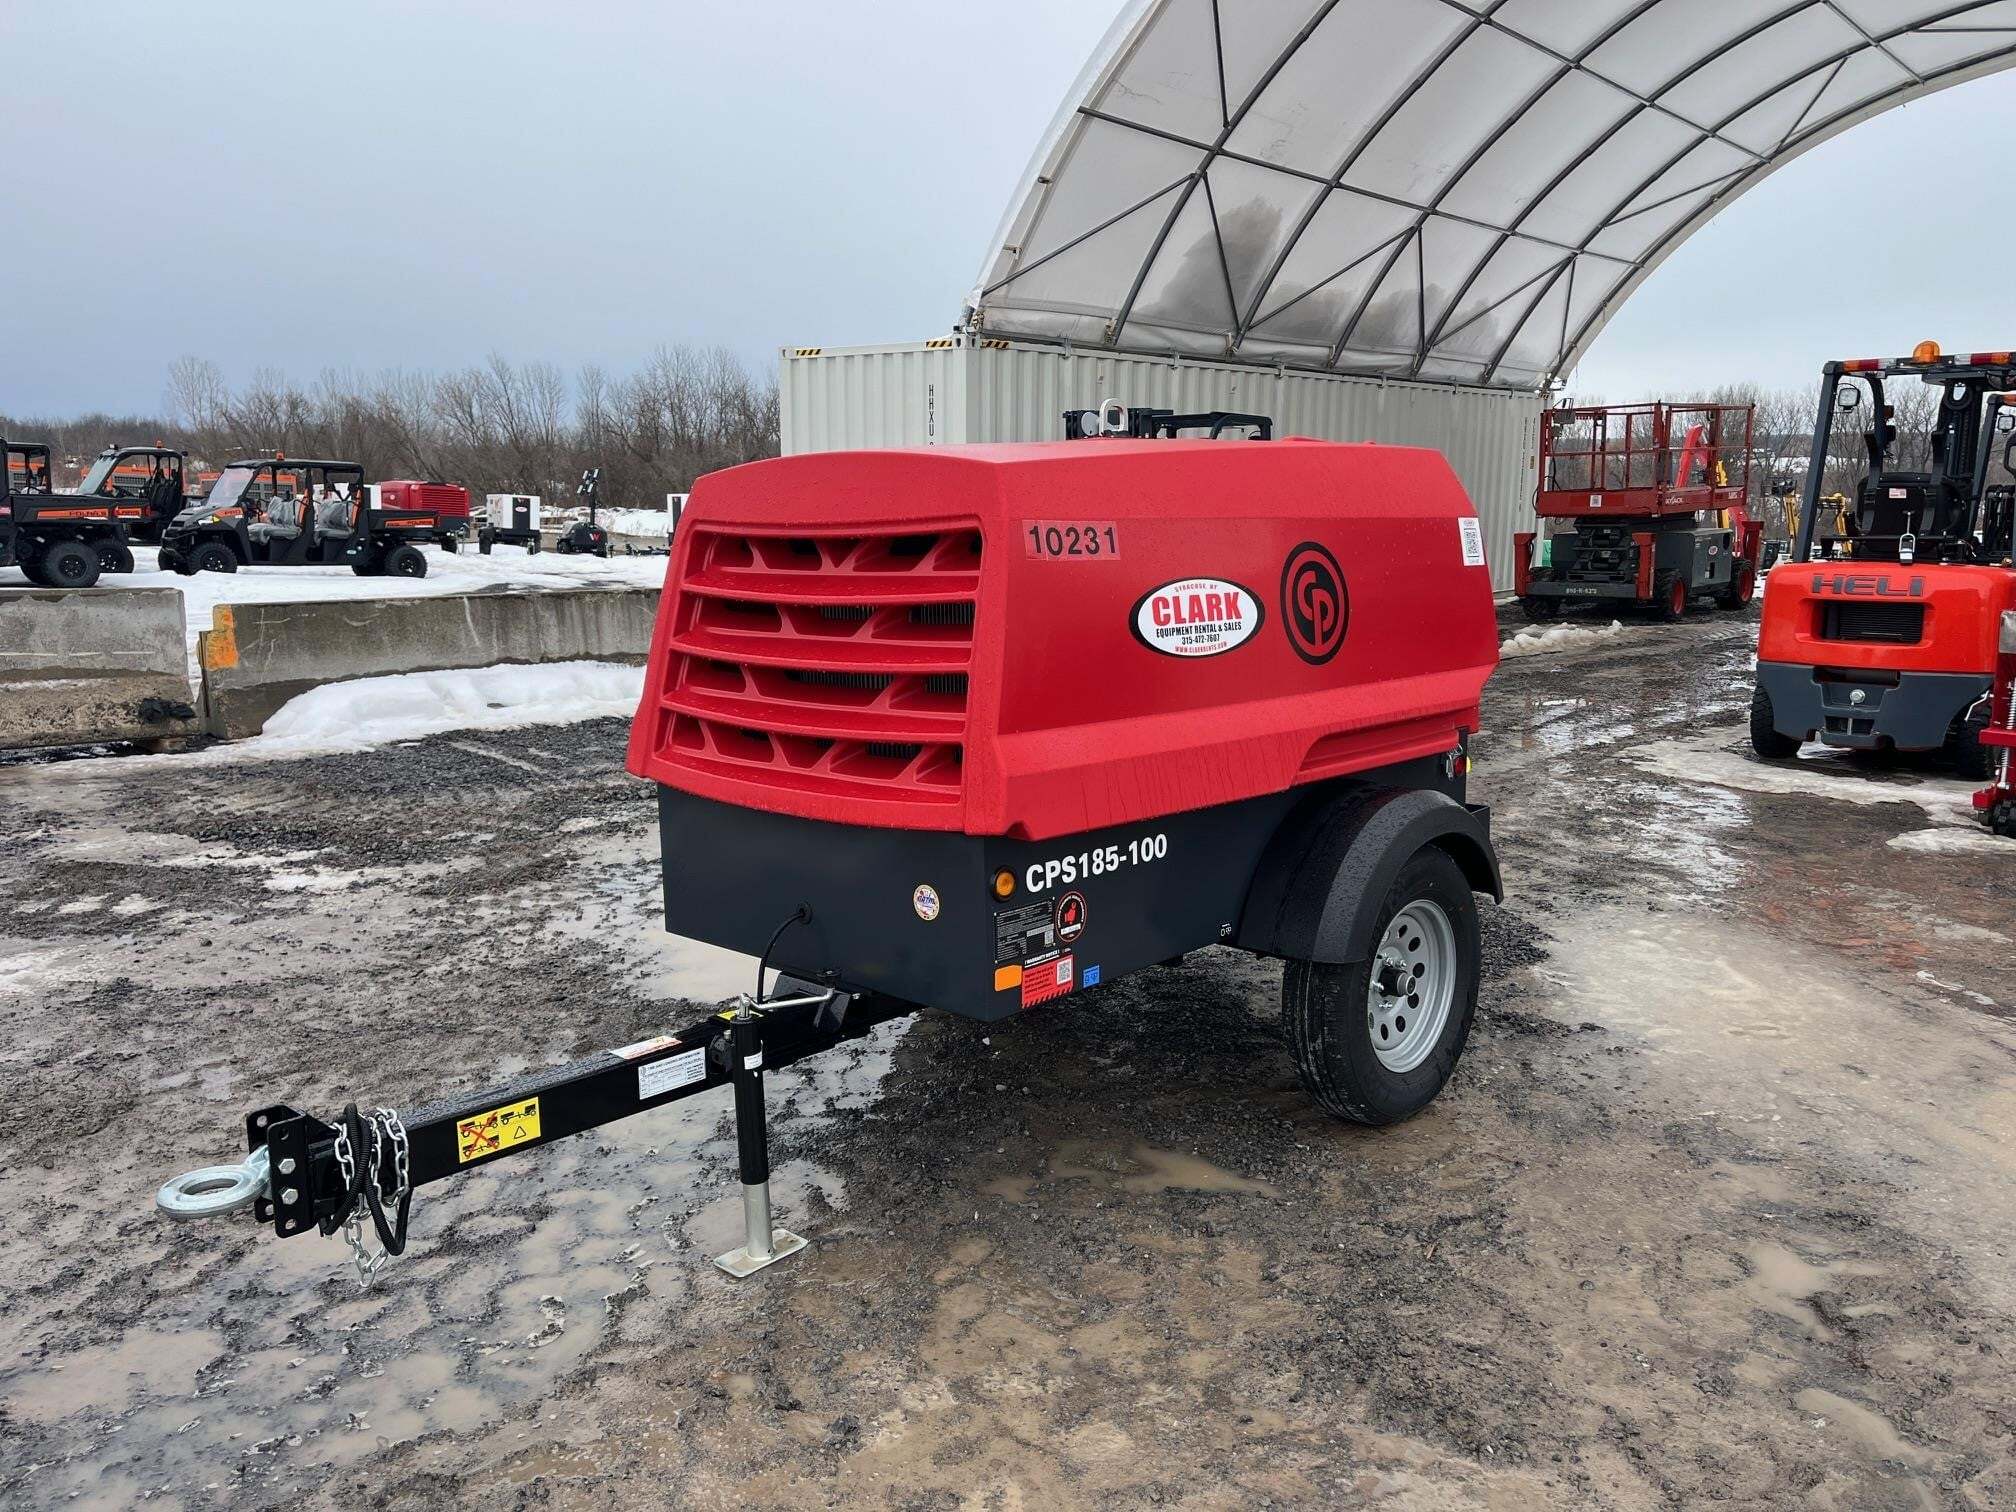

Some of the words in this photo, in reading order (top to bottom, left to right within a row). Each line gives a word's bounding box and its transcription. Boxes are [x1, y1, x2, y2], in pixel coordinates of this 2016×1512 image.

[1029, 525, 1116, 556] 10231
[1811, 574, 1924, 597] HELI
[1151, 591, 1243, 627] CLARK
[1156, 625, 1193, 639] EQUIPMENT
[1194, 623, 1217, 635] RENTAL
[1217, 624, 1223, 632] &
[1223, 621, 1242, 632] SALES
[1025, 833, 1168, 893] CPS185-100
